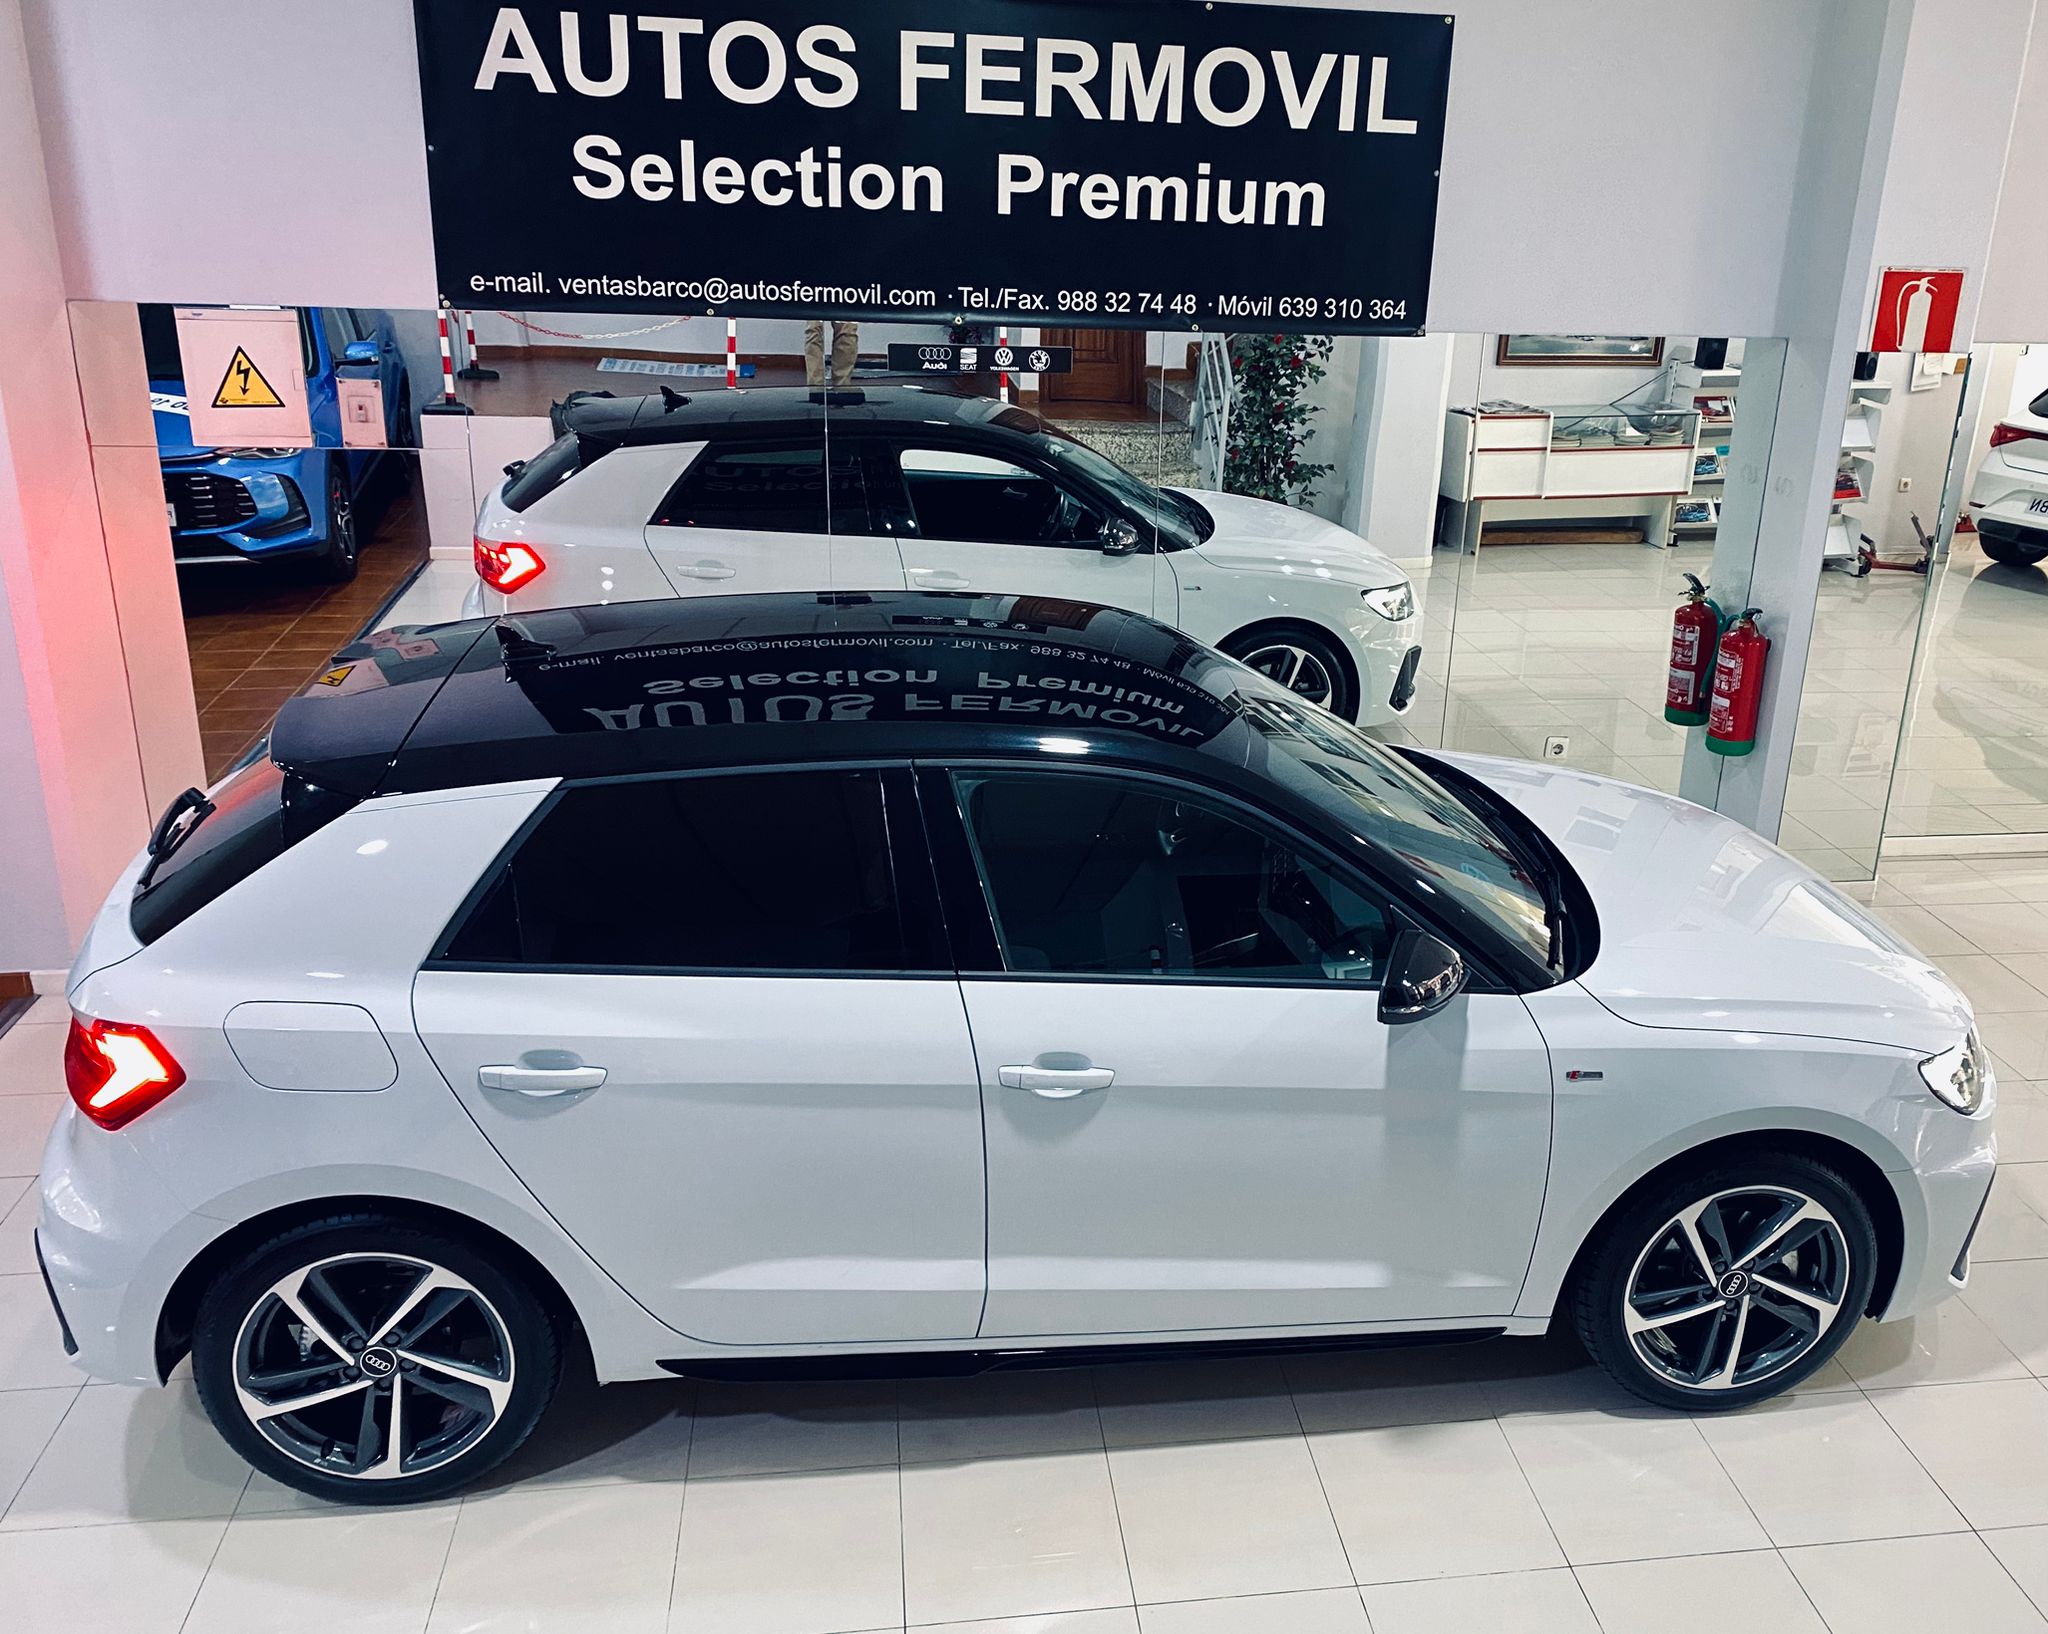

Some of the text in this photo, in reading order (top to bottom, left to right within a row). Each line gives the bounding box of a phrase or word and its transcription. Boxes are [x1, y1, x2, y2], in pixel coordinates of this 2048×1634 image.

[474, 7, 1418, 135] AUTOS FERMOVIL
[572, 134, 1326, 227] Selection Premium
[470, 271, 551, 294] e-mail.
[557, 274, 936, 307] ventasbarco@autosfermovil.com
[1057, 290, 1098, 312] 988
[1104, 291, 1131, 313] 32
[1138, 292, 1164, 314] 74
[1169, 293, 1197, 315] 48
[1278, 296, 1318, 318] 639
[1324, 297, 1363, 319] 310
[1368, 299, 1407, 320] 364
[922, 361, 948, 370] Audi
